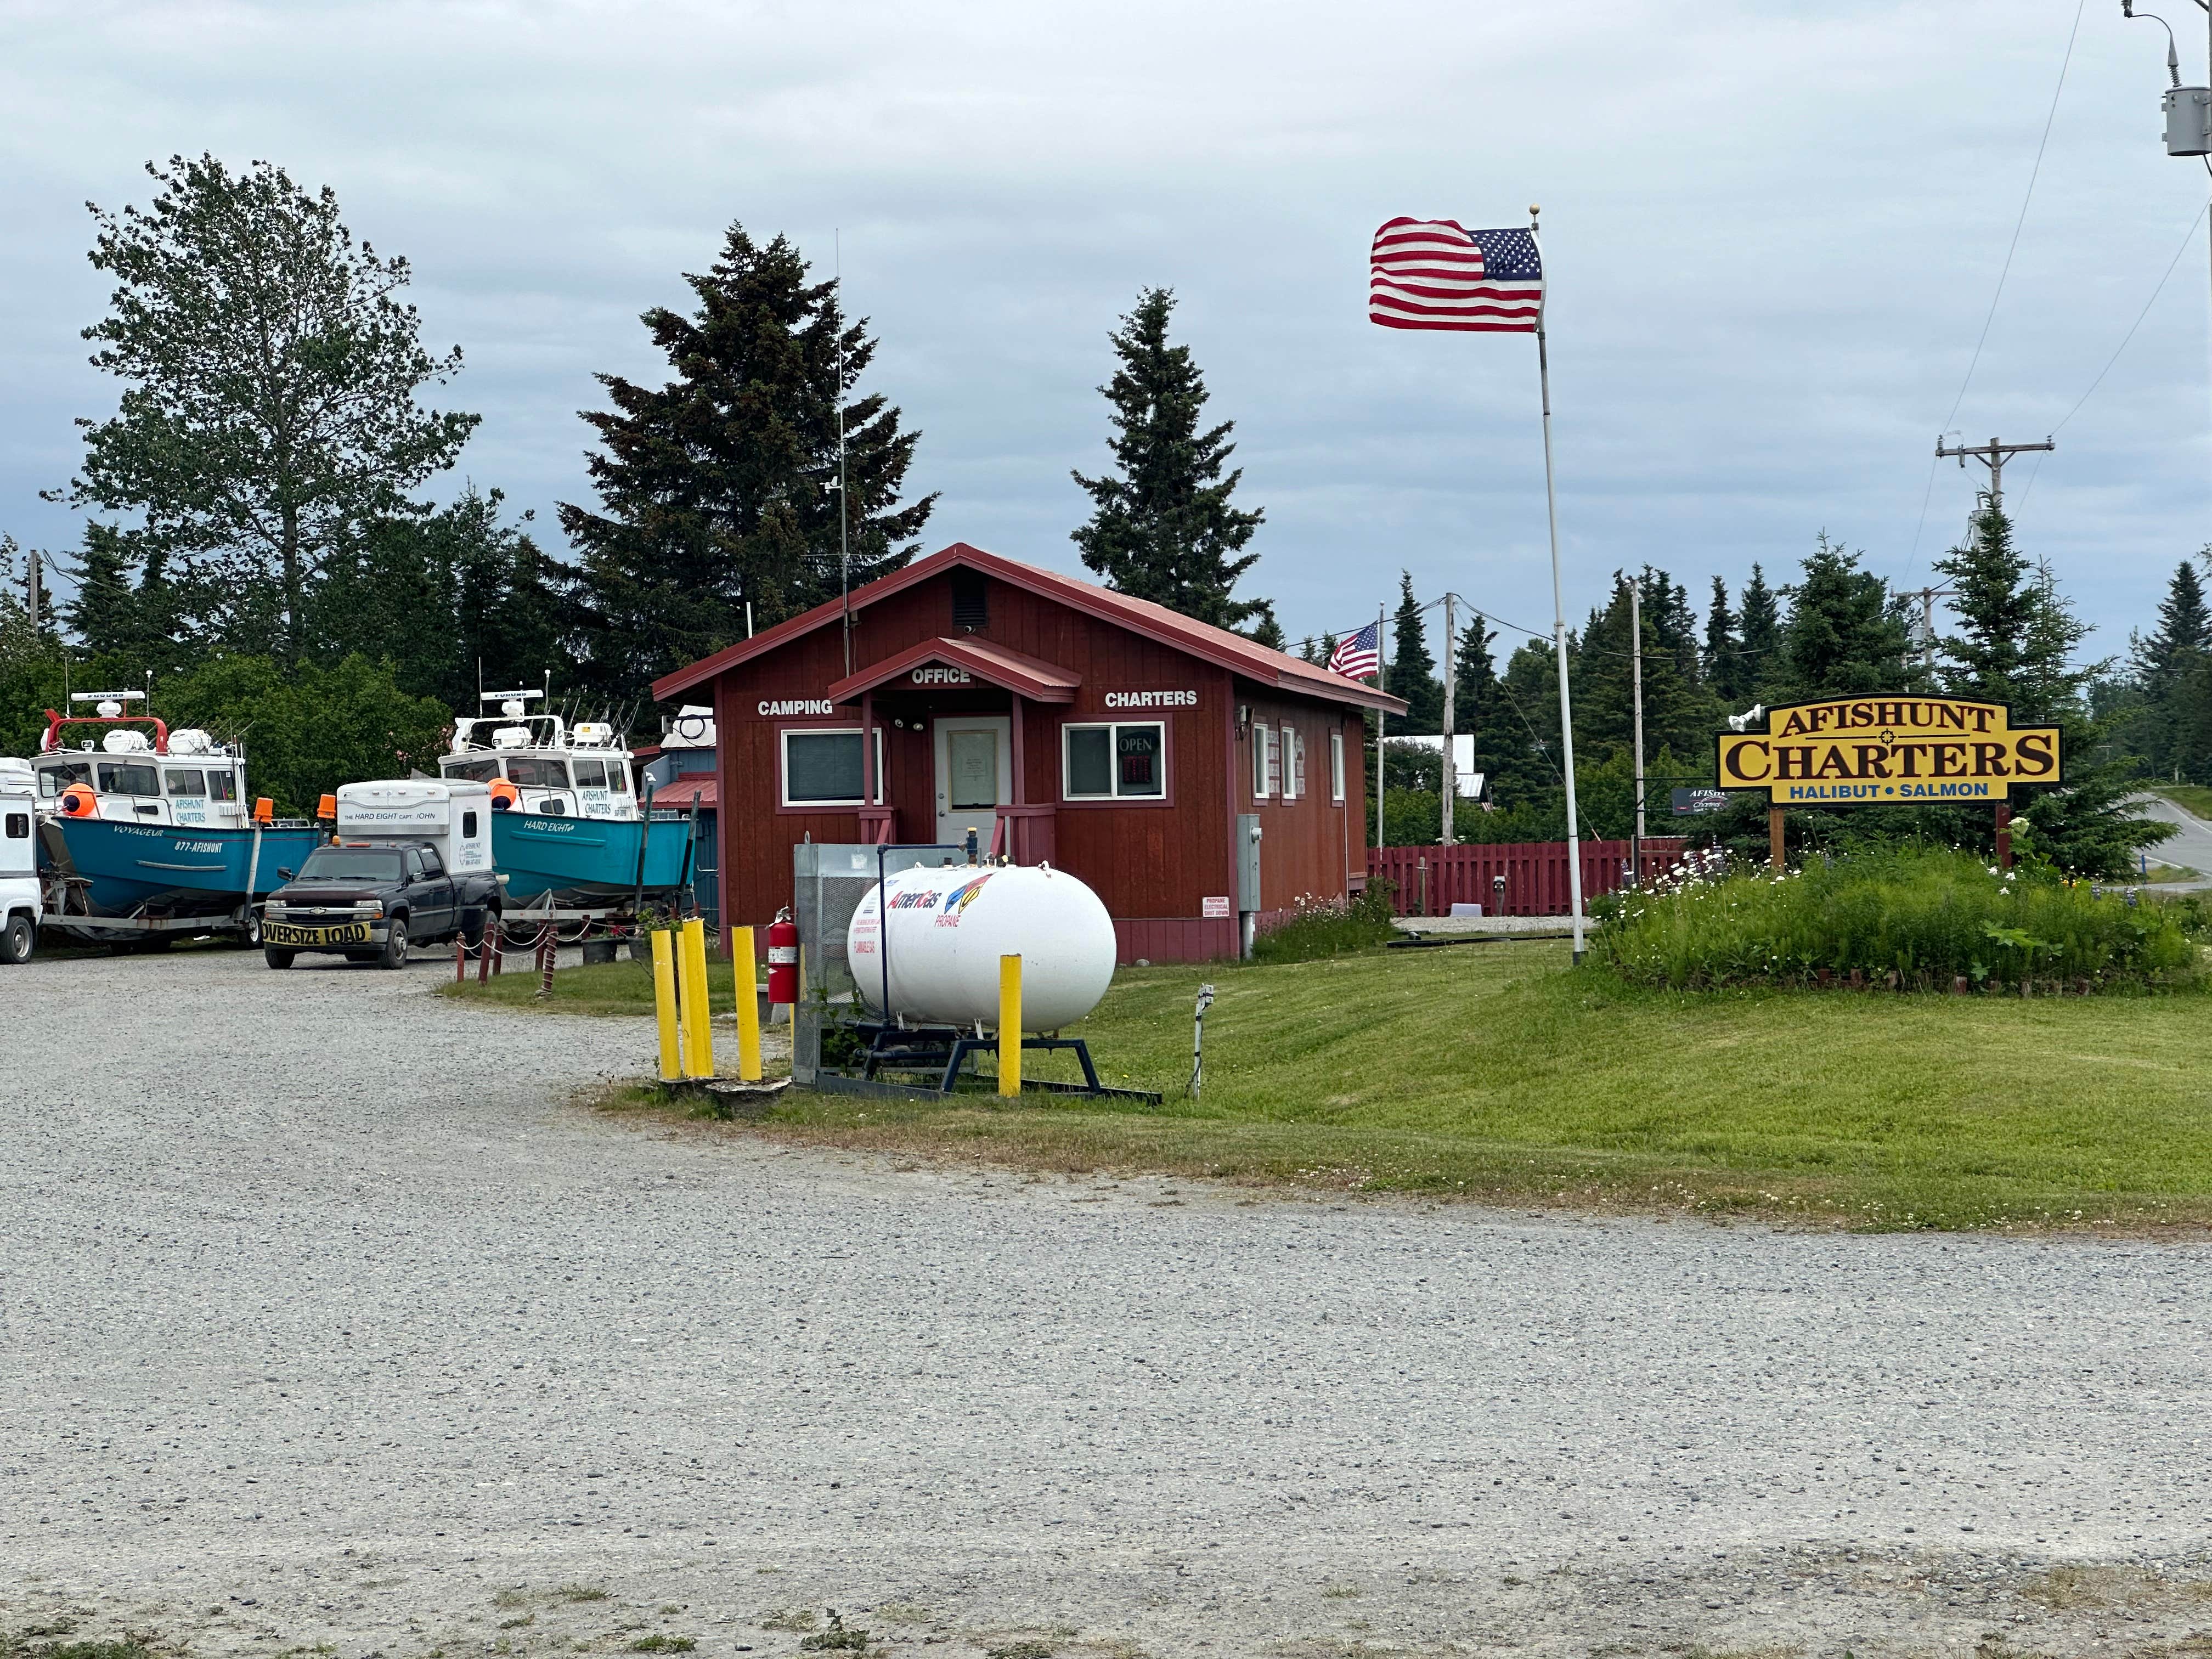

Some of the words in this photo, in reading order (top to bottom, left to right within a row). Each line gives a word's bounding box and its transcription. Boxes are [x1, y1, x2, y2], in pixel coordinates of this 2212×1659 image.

[912, 668, 970, 684] OFFICE
[1105, 690, 1197, 707] CHARTERS
[758, 699, 833, 715] CAMPING
[1778, 702, 1996, 738] AFISHUNT
[1119, 737, 1152, 752] OPEN
[1725, 734, 2055, 781] CHARTERS
[582, 790, 608, 801] AFISHUNT
[1790, 785, 1881, 799] HALIBUT
[1900, 782, 1989, 798] SALMON
[176, 799, 205, 809] AFISHUNT
[585, 803, 611, 815] CHARTERS
[176, 812, 206, 823] CHARTERS
[114, 825, 163, 836] VOYAGEUR
[524, 820, 548, 831] HARD
[175, 841, 222, 853] 877-AFISHUNT
[934, 915, 961, 928] PROPANE
[263, 923, 320, 944] OVERSIZE
[324, 924, 366, 944] LOAD
